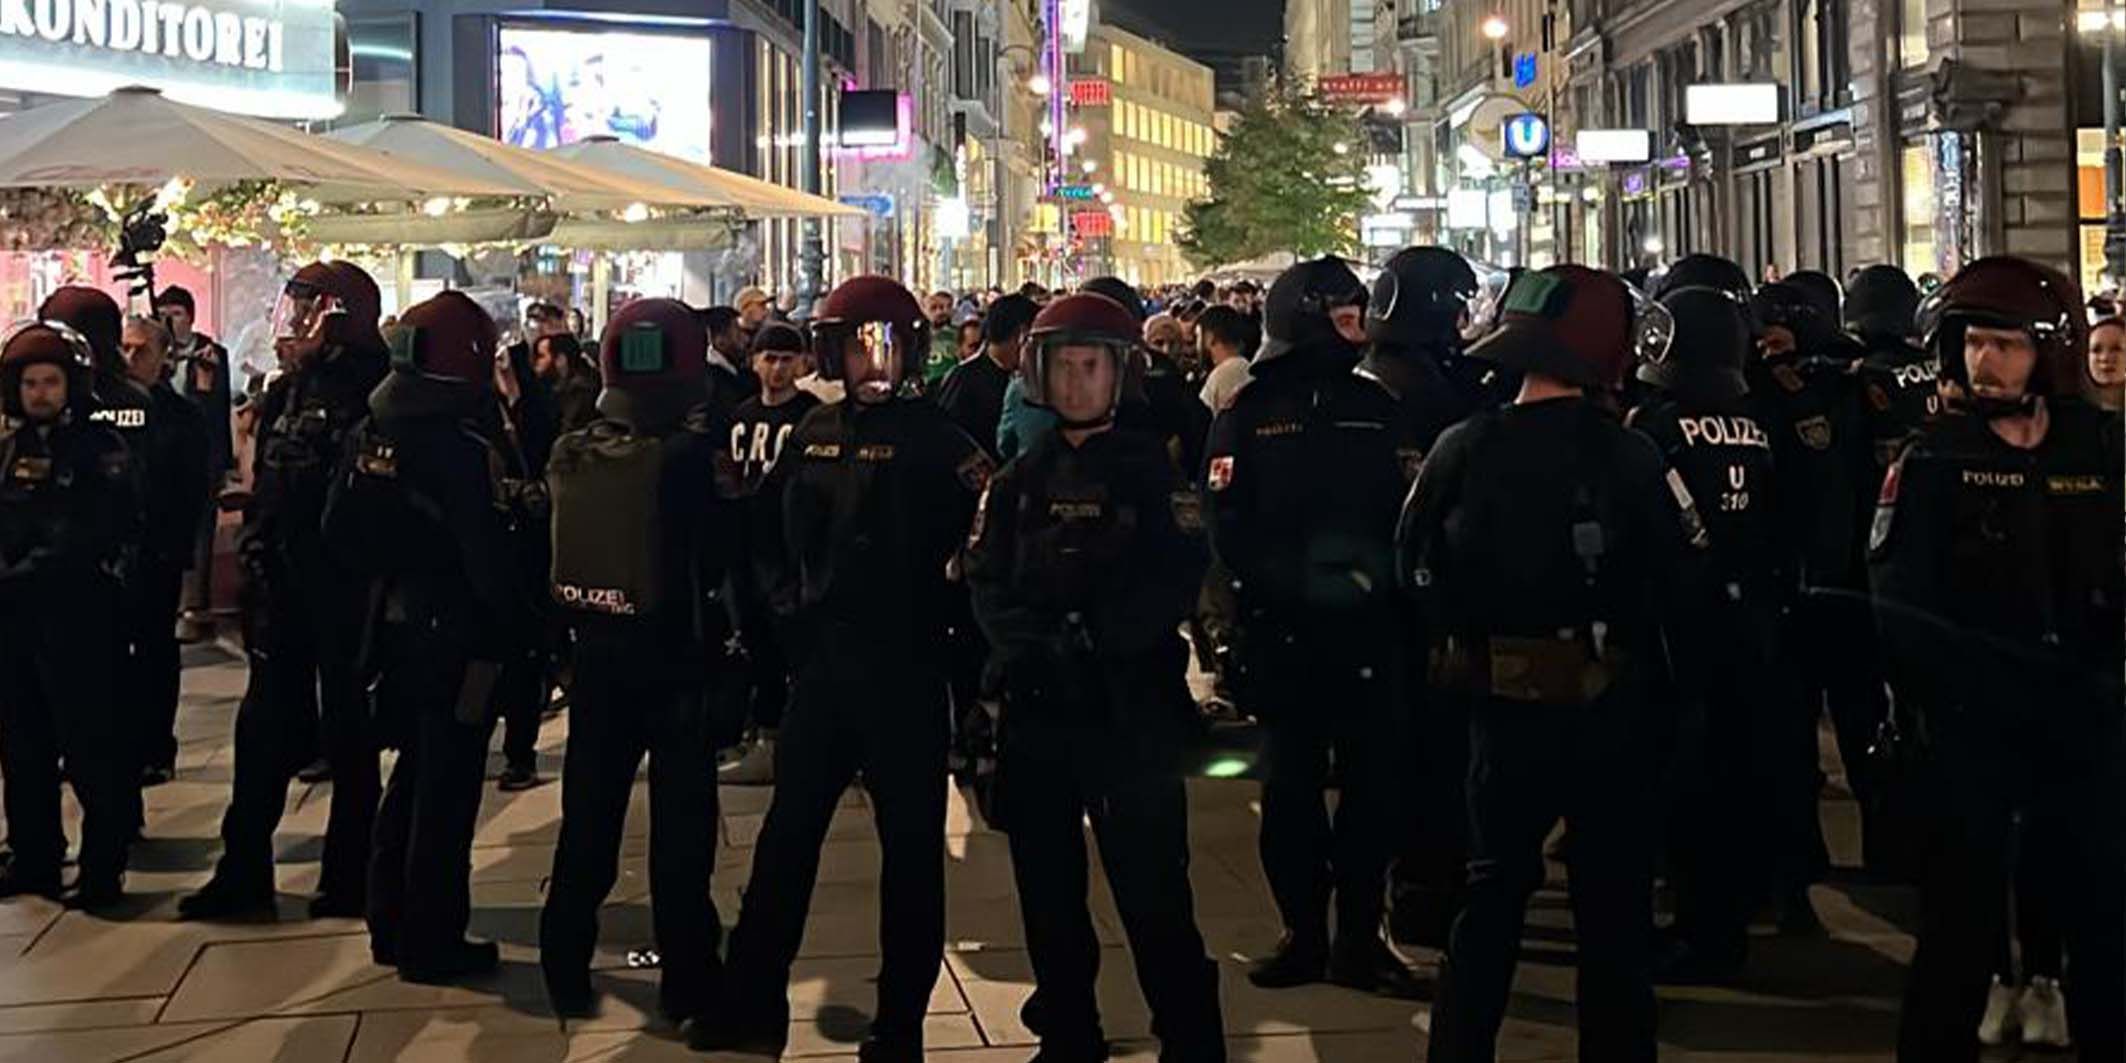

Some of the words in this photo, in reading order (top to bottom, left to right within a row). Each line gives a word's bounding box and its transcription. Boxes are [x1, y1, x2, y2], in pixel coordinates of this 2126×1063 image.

[0, 0, 283, 72] KONDITOREI
[1512, 114, 1545, 154] U
[1926, 395, 1938, 414] U
[1729, 465, 1745, 490] U
